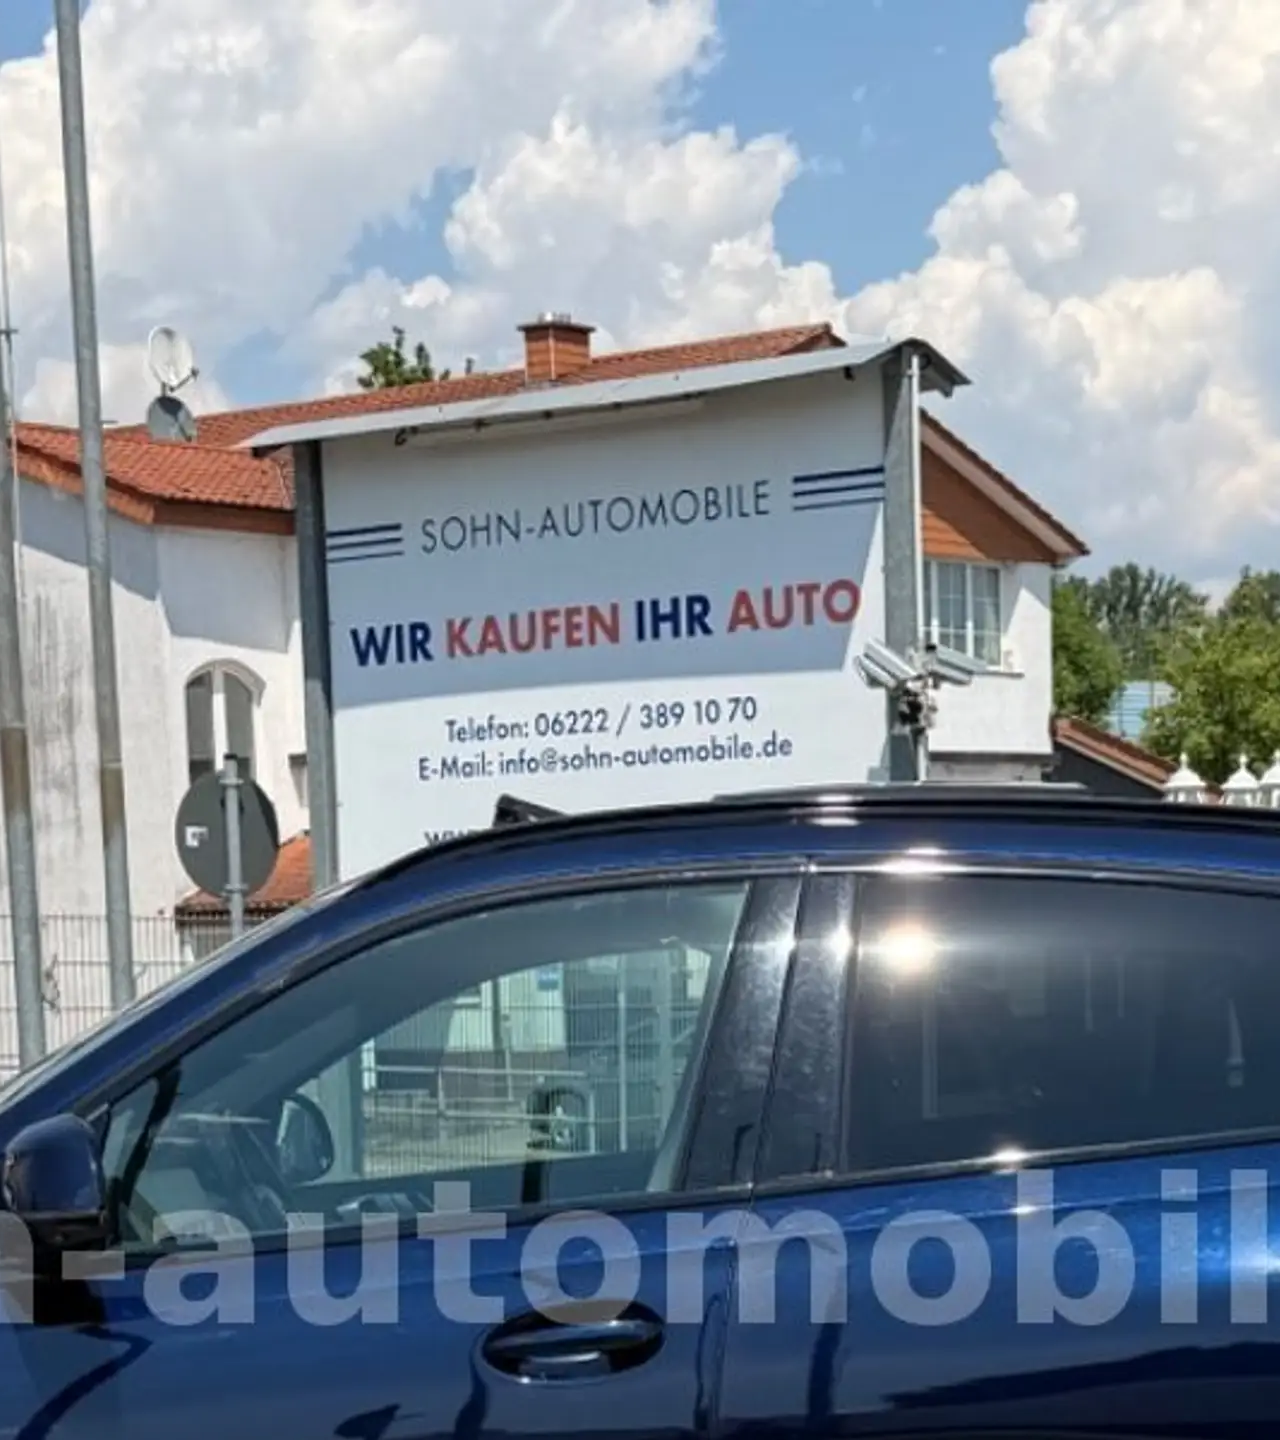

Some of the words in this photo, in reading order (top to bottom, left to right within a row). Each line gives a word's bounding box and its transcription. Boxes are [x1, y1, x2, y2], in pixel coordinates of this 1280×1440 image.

[422, 479, 771, 555] SOHN-AUTOMOBILE
[350, 620, 434, 667] WIR
[445, 602, 621, 659] KAUFEN
[635, 594, 713, 643] IHR
[727, 578, 862, 634] AUTO
[445, 714, 529, 744] Telefon:
[534, 708, 609, 738] 06222
[615, 702, 631, 738] /
[639, 702, 685, 730] 389
[695, 699, 721, 727] 10
[727, 695, 758, 724] 70
[418, 753, 494, 782] E-Mail:
[498, 730, 793, 777] info@sohn-automobile.de
